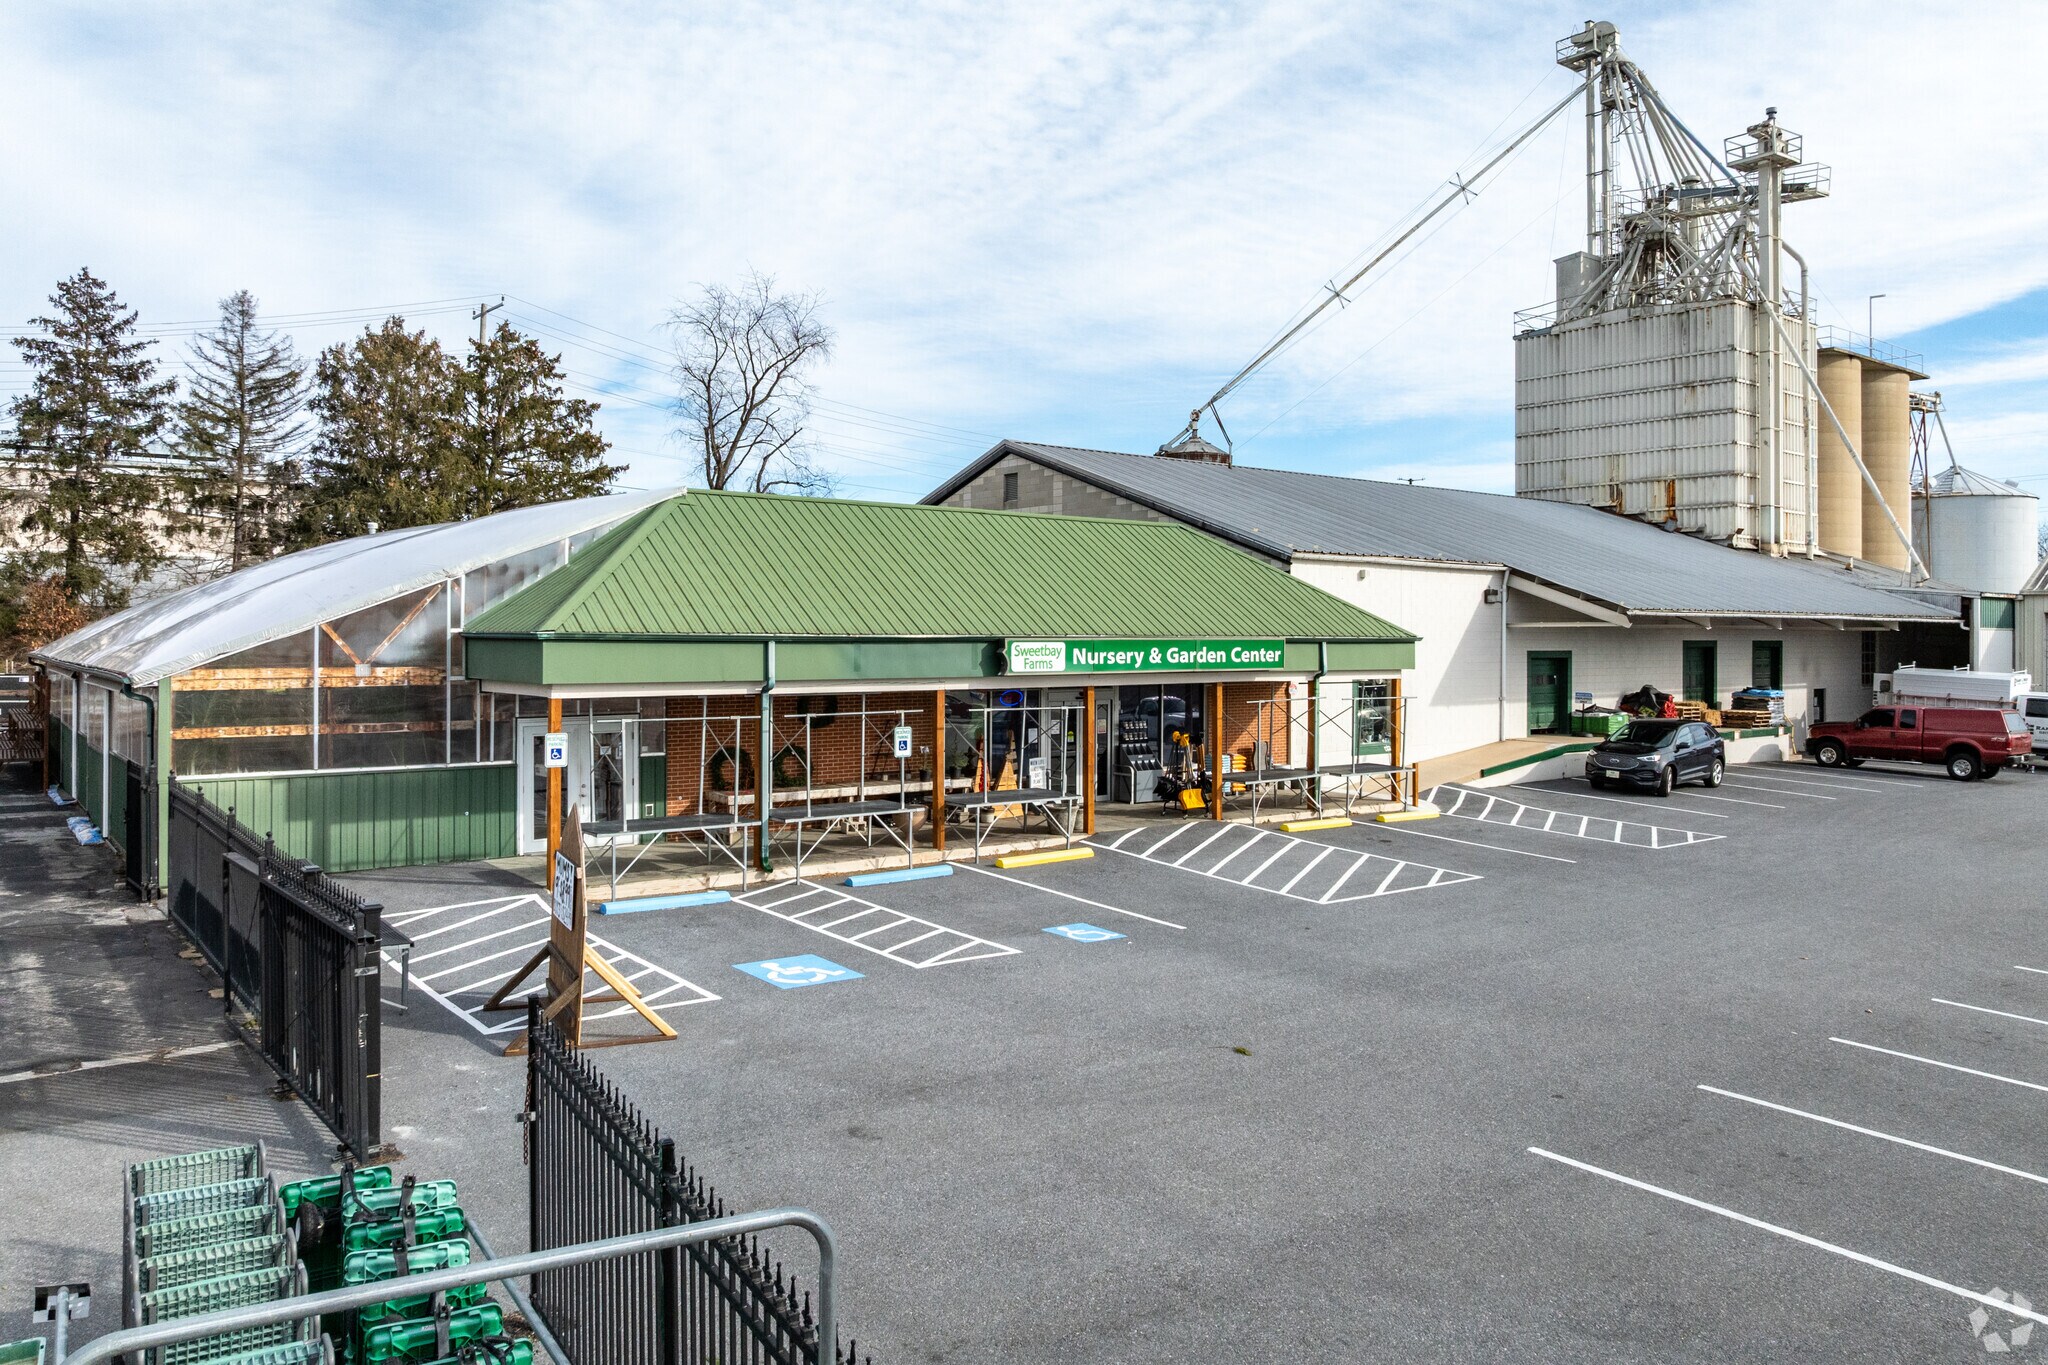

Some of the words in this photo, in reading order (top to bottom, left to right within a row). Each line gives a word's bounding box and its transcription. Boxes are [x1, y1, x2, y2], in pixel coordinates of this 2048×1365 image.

[1014, 644, 1063, 659] Sweetbay
[1073, 647, 1144, 669] Nursery
[1149, 647, 1162, 664] &
[1166, 646, 1226, 664] Garden
[1231, 646, 1282, 663] Center
[1023, 658, 1053, 670] Farms
